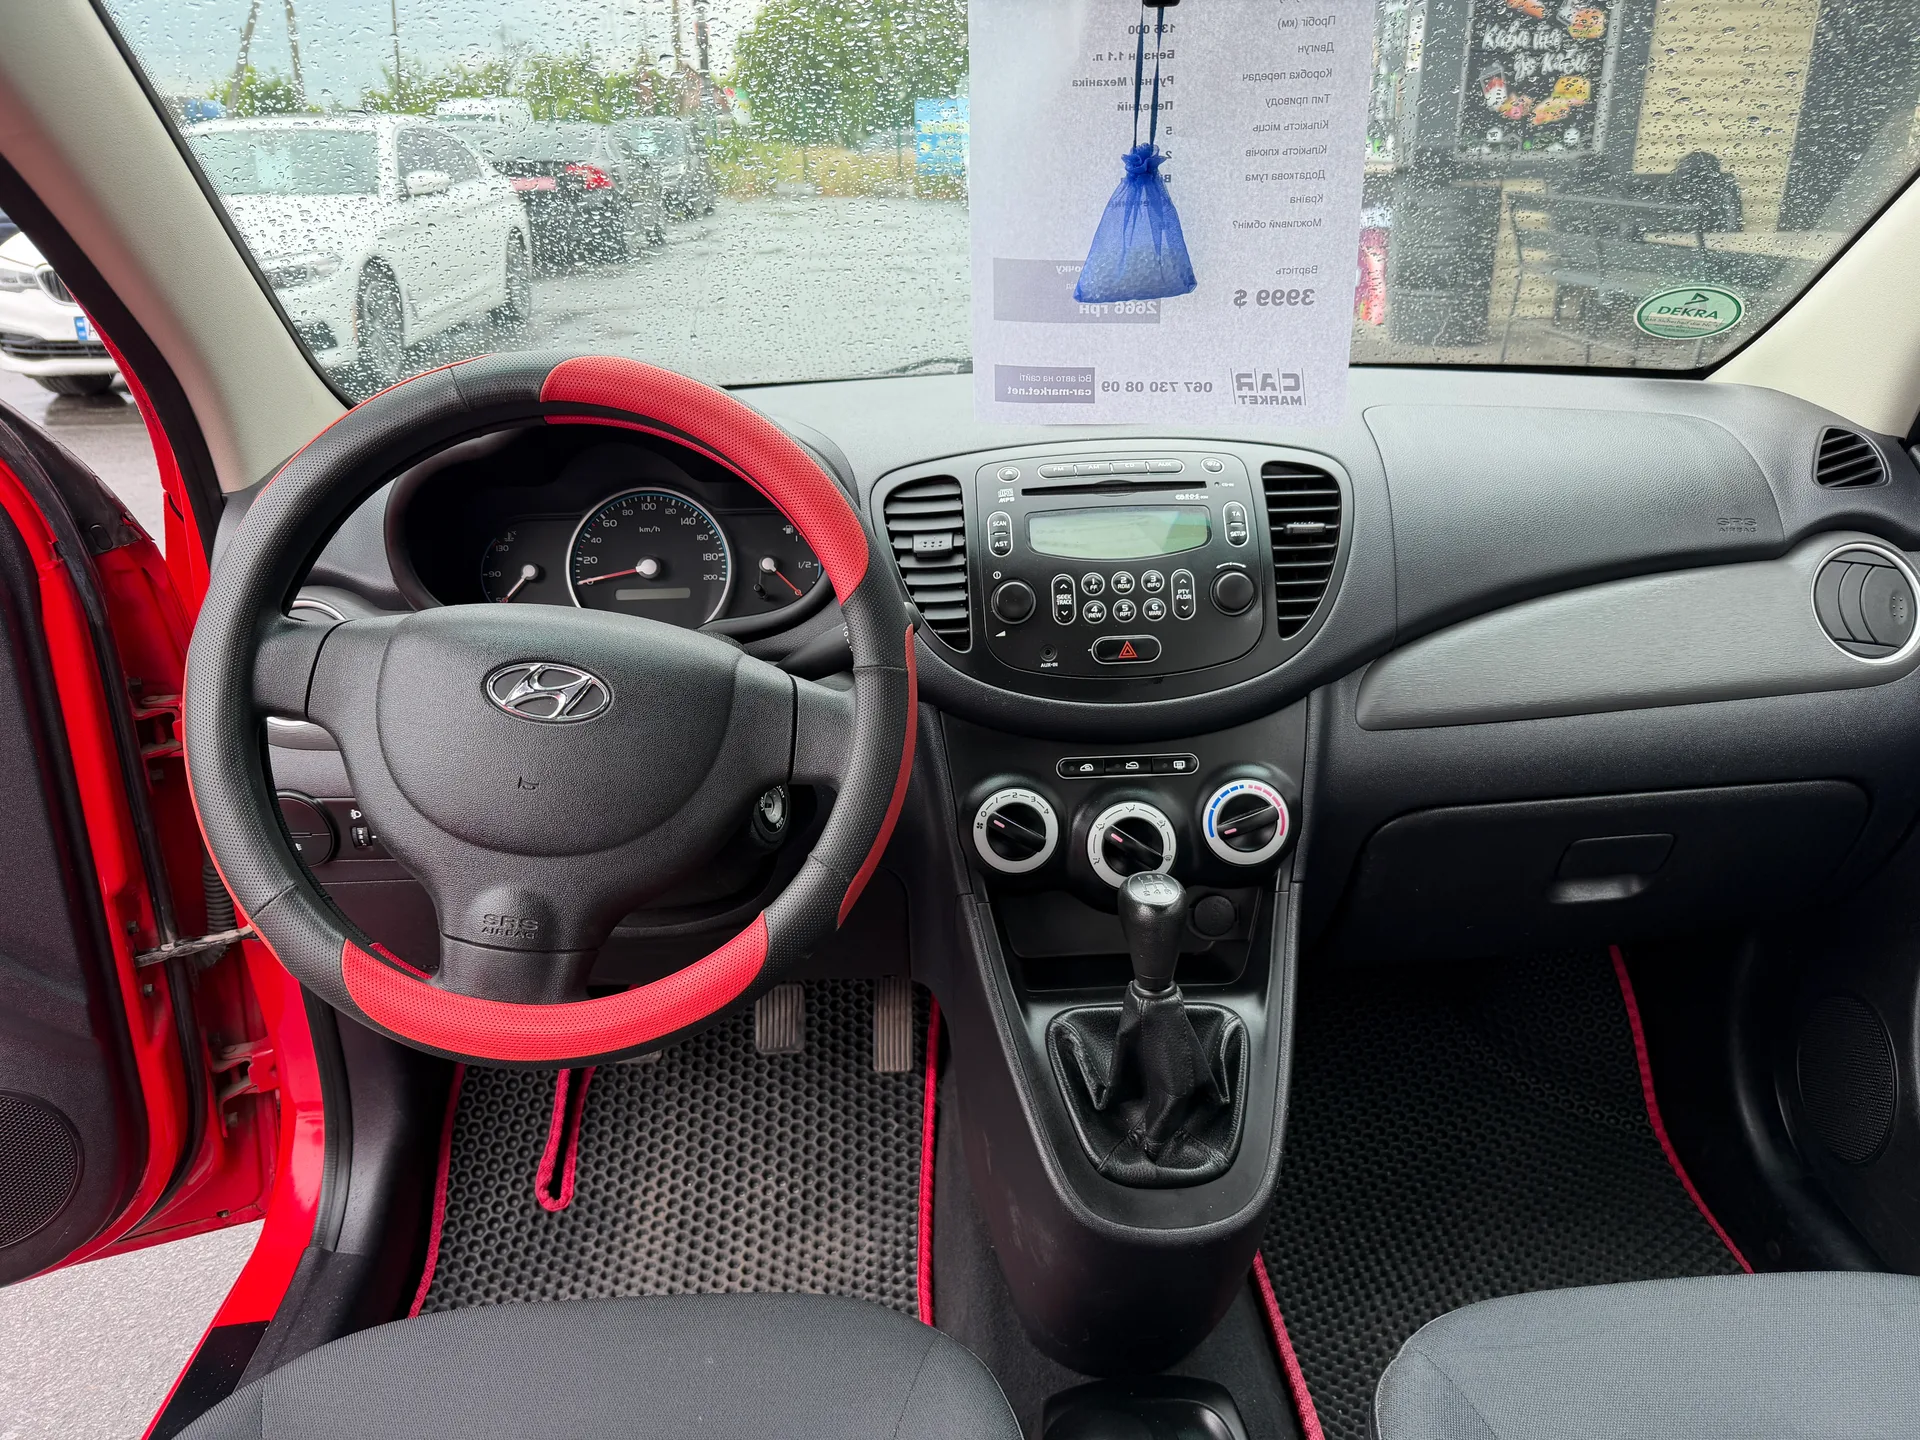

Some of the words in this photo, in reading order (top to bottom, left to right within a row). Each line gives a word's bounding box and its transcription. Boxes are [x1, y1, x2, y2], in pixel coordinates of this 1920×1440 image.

[1657, 306, 1718, 319] DEKRA
[641, 502, 657, 511] 100
[602, 519, 617, 528] 60
[680, 517, 696, 526] 140
[1716, 517, 1757, 526] SRS
[994, 540, 1009, 548] AST
[583, 556, 598, 564] 20
[702, 553, 719, 561] 180
[798, 561, 812, 569] 1/2
[483, 913, 539, 930] SRS
